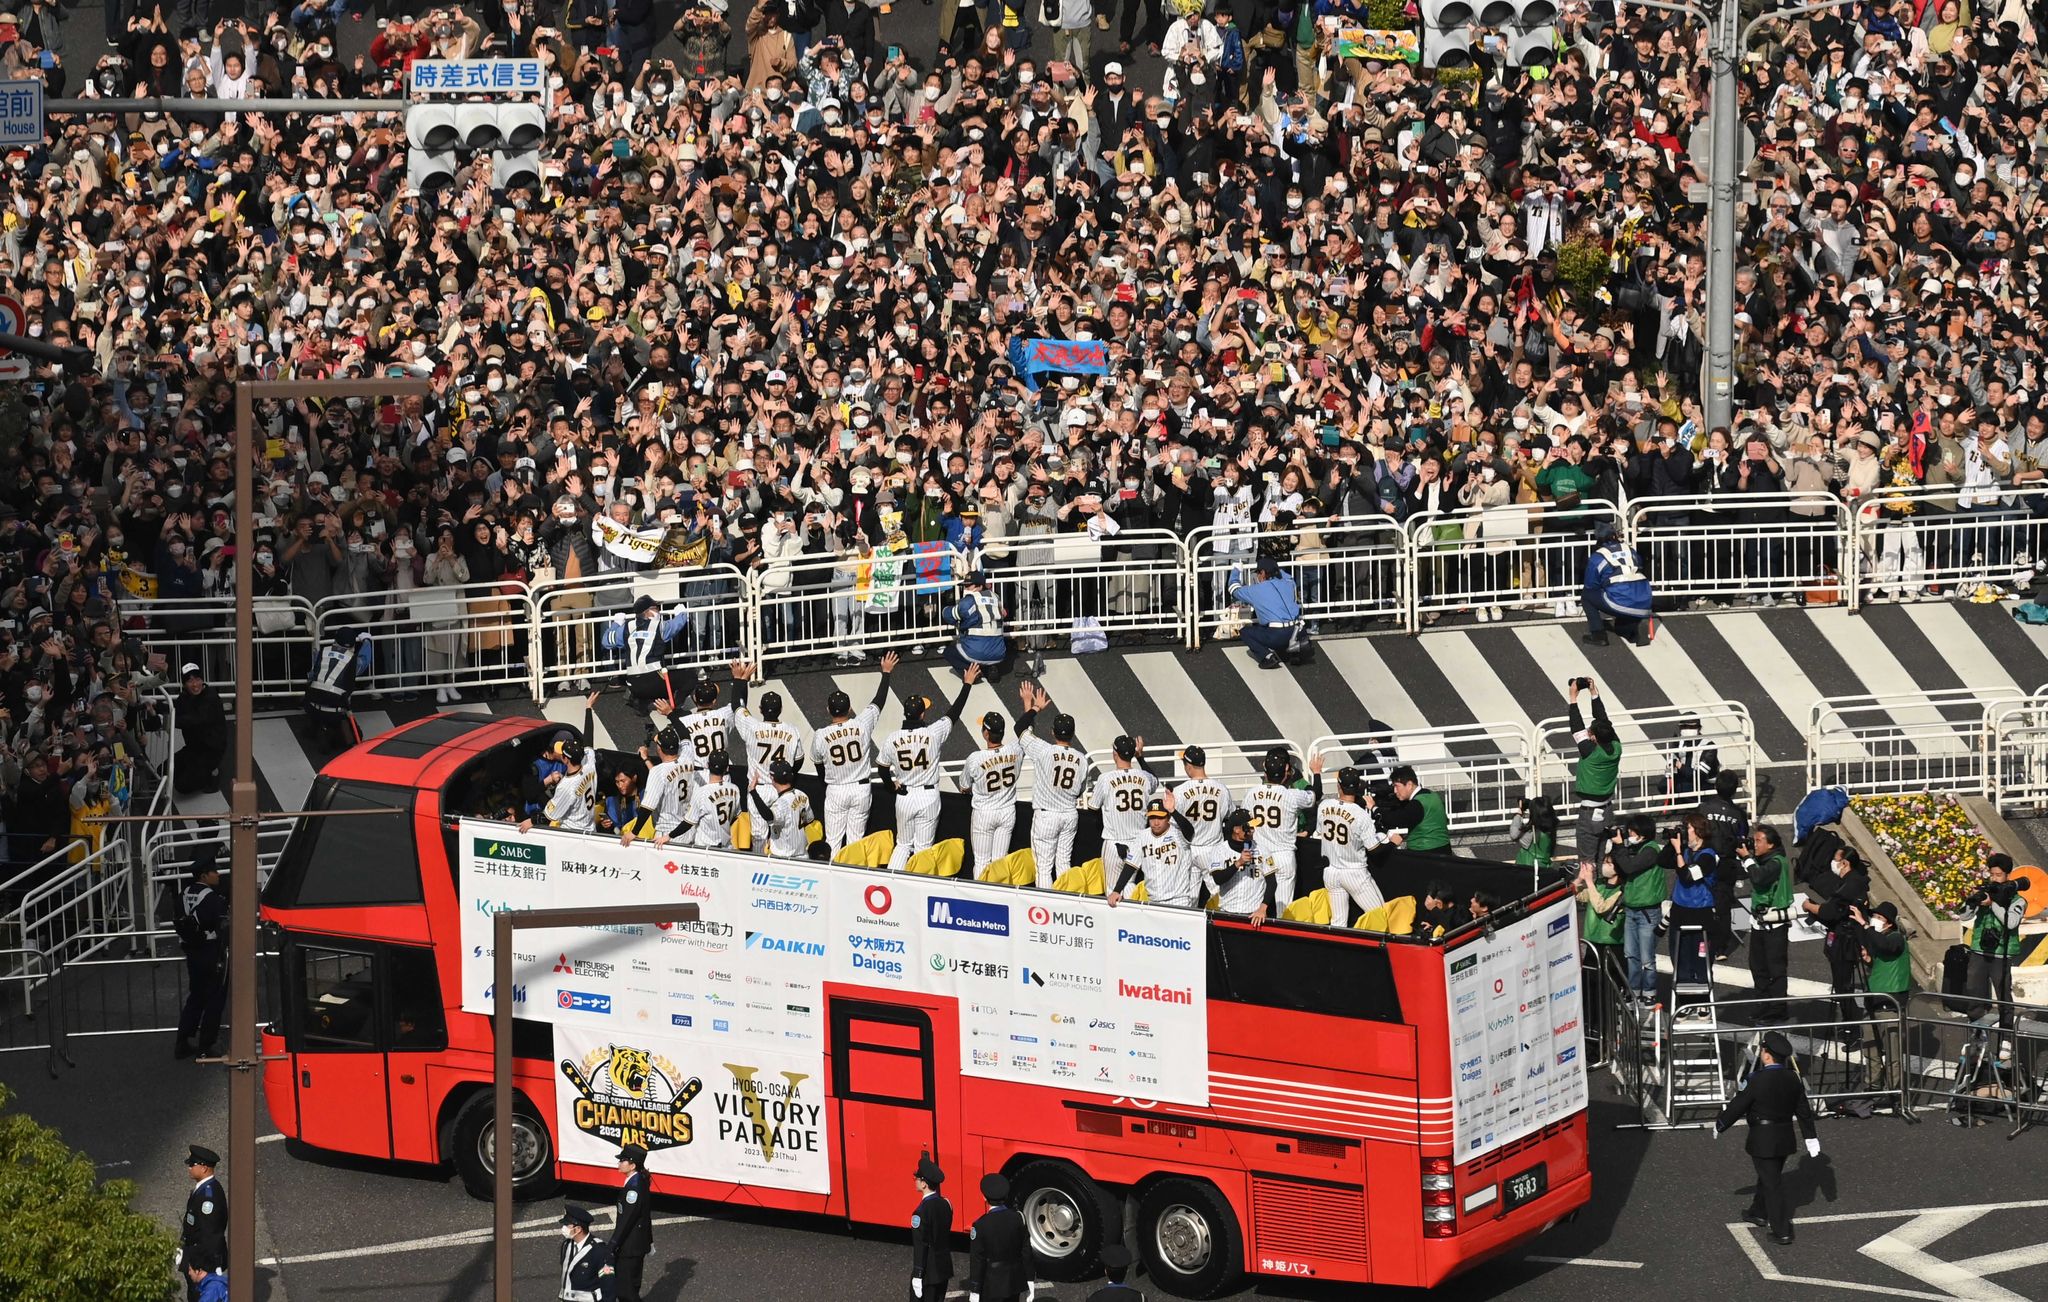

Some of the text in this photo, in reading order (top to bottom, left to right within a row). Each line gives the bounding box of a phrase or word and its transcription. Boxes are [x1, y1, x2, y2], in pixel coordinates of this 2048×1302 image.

[415, 63, 539, 88] 時差式信号
[4, 120, 35, 134] House
[689, 717, 725, 734] OKADA
[693, 731, 725, 758] 80
[755, 729, 793, 743] FUJIMOTO
[824, 727, 860, 744] KUBOTA
[892, 734, 930, 749] KAJIYA
[757, 742, 785, 765] 74
[829, 740, 862, 767] 90
[897, 748, 929, 771] 54
[1053, 752, 1080, 766] BABA
[985, 765, 1016, 793] 25
[1053, 765, 1076, 790] 18
[584, 786, 594, 811] 5
[677, 779, 688, 801] 3
[1183, 785, 1222, 800] OHTAKE
[1253, 791, 1283, 802] ISHII
[1115, 788, 1143, 812] 36
[716, 801, 734, 825] 51
[1185, 799, 1218, 822] 49
[1253, 804, 1281, 829] 69
[1707, 813, 1738, 825] STAFF
[1323, 819, 1348, 846] 39
[500, 845, 531, 859] SMBC
[1142, 840, 1177, 860] Tigers
[1164, 855, 1178, 866] 47
[473, 861, 547, 882] 三井住友銀行
[561, 860, 642, 881] 阪神タイガース
[680, 863, 720, 879] 住友生命
[680, 881, 711, 903] Vitality
[751, 898, 819, 915] JR西日本グループ
[677, 920, 733, 938] 関西電力
[856, 915, 900, 928] Daiwa House
[955, 917, 1007, 931] Osaka Metro
[1052, 911, 1094, 929] MUFG
[661, 935, 728, 951] power with heart
[761, 936, 826, 957] DAIKIN
[863, 936, 905, 954] 大阪ガス
[1029, 931, 1094, 949] 三菱UFJ銀行
[1118, 928, 1191, 951] Panasonic
[513, 952, 536, 963] TRUST
[574, 959, 615, 972] MITSUBISHI
[852, 952, 902, 974] Daigas
[1548, 952, 1573, 969] Panasonic
[574, 968, 610, 979] ELECTRIC
[949, 958, 1009, 979] りそな銀行
[1049, 972, 1102, 986] KINTETSU
[1049, 980, 1102, 993] GROUP HOLDINGS
[1118, 979, 1192, 1005] Iwatani
[1554, 984, 1577, 1000] DAIKIN
[572, 996, 610, 1010] コーナン
[712, 999, 735, 1008] sysmex
[981, 1005, 998, 1015] TOA
[1097, 1020, 1116, 1030] asics
[1487, 1013, 1514, 1032] Kubota
[1553, 1016, 1578, 1037] Iwatani
[1461, 1069, 1482, 1082] Daigas
[592, 1093, 672, 1113] JERA CENTRAL LEAGUE
[714, 1092, 820, 1127] VICTORY
[576, 1099, 691, 1142] CHAMPIONS
[600, 1125, 621, 1138] 2023
[621, 1127, 649, 1150] ARE
[646, 1133, 673, 1145] Tigers
[719, 1119, 818, 1153] PARADE
[1261, 1258, 1311, 1276] 神姫バス
